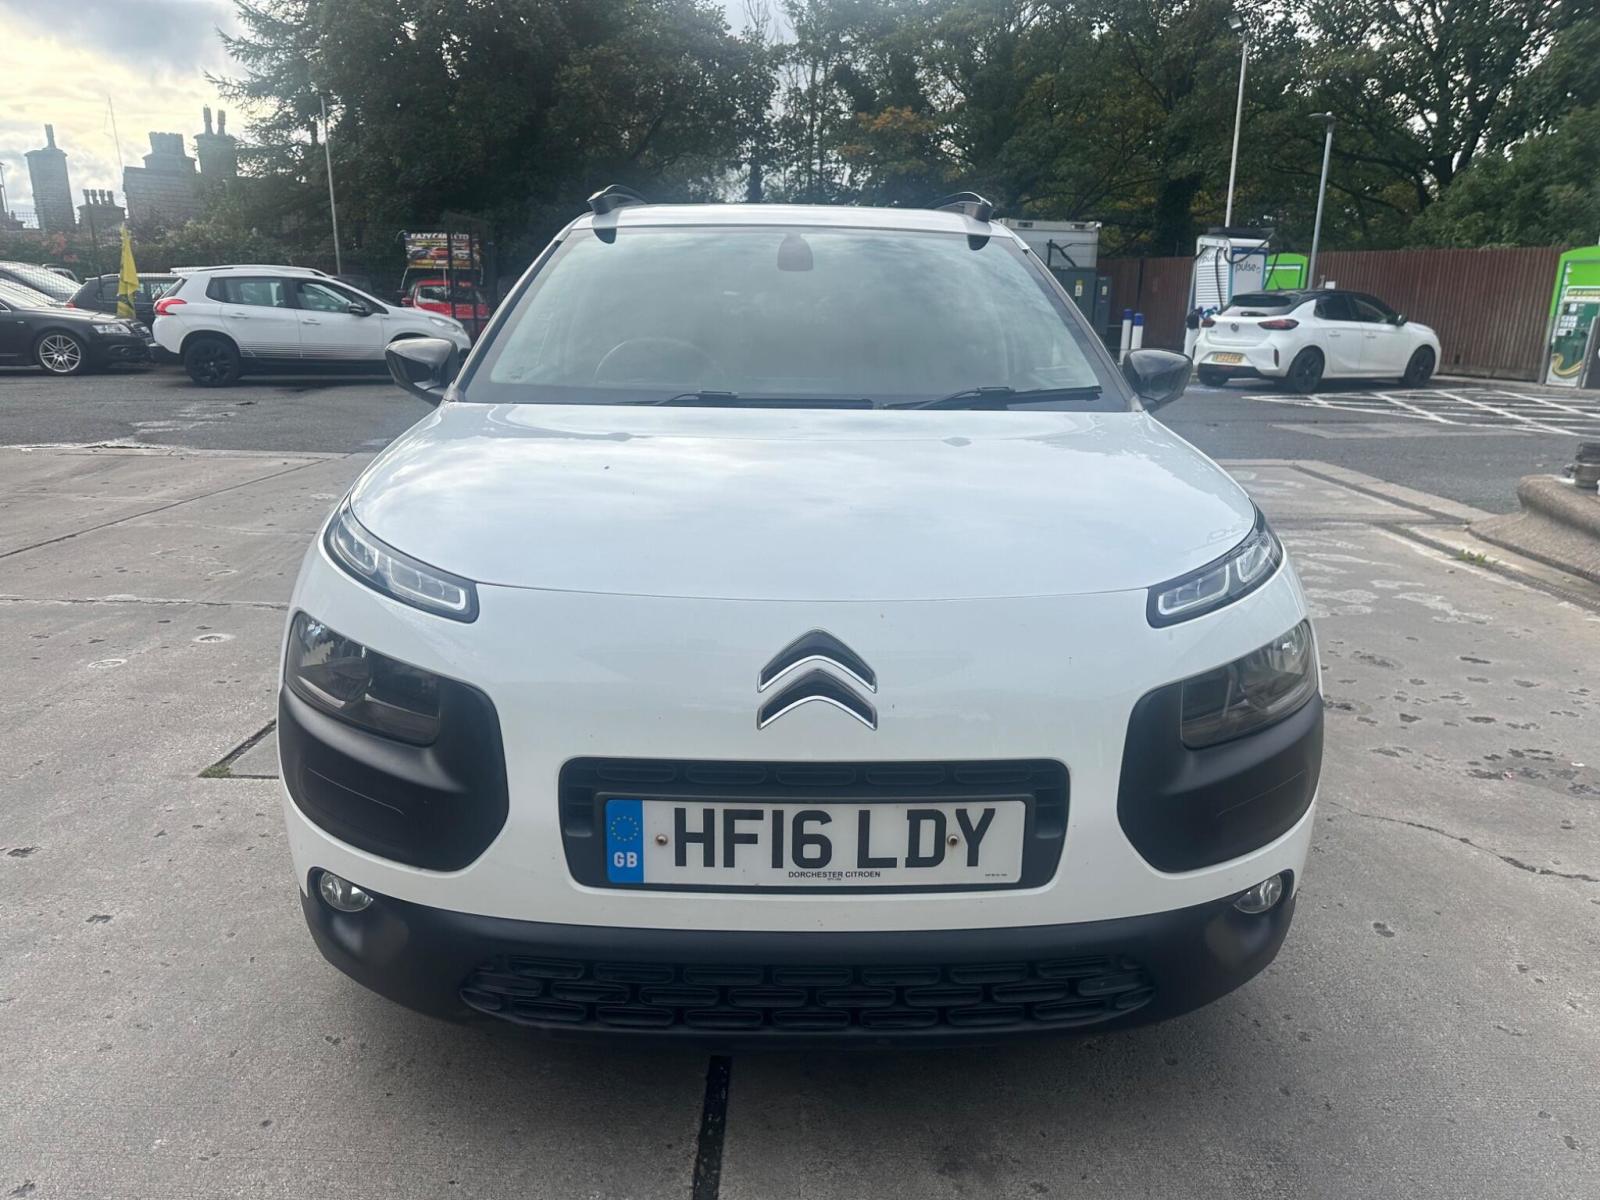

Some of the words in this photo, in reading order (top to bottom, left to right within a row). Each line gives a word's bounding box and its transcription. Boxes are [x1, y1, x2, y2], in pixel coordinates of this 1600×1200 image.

[674, 807, 832, 869] HF16
[857, 808, 996, 868] LDY
[614, 852, 637, 867] GB
